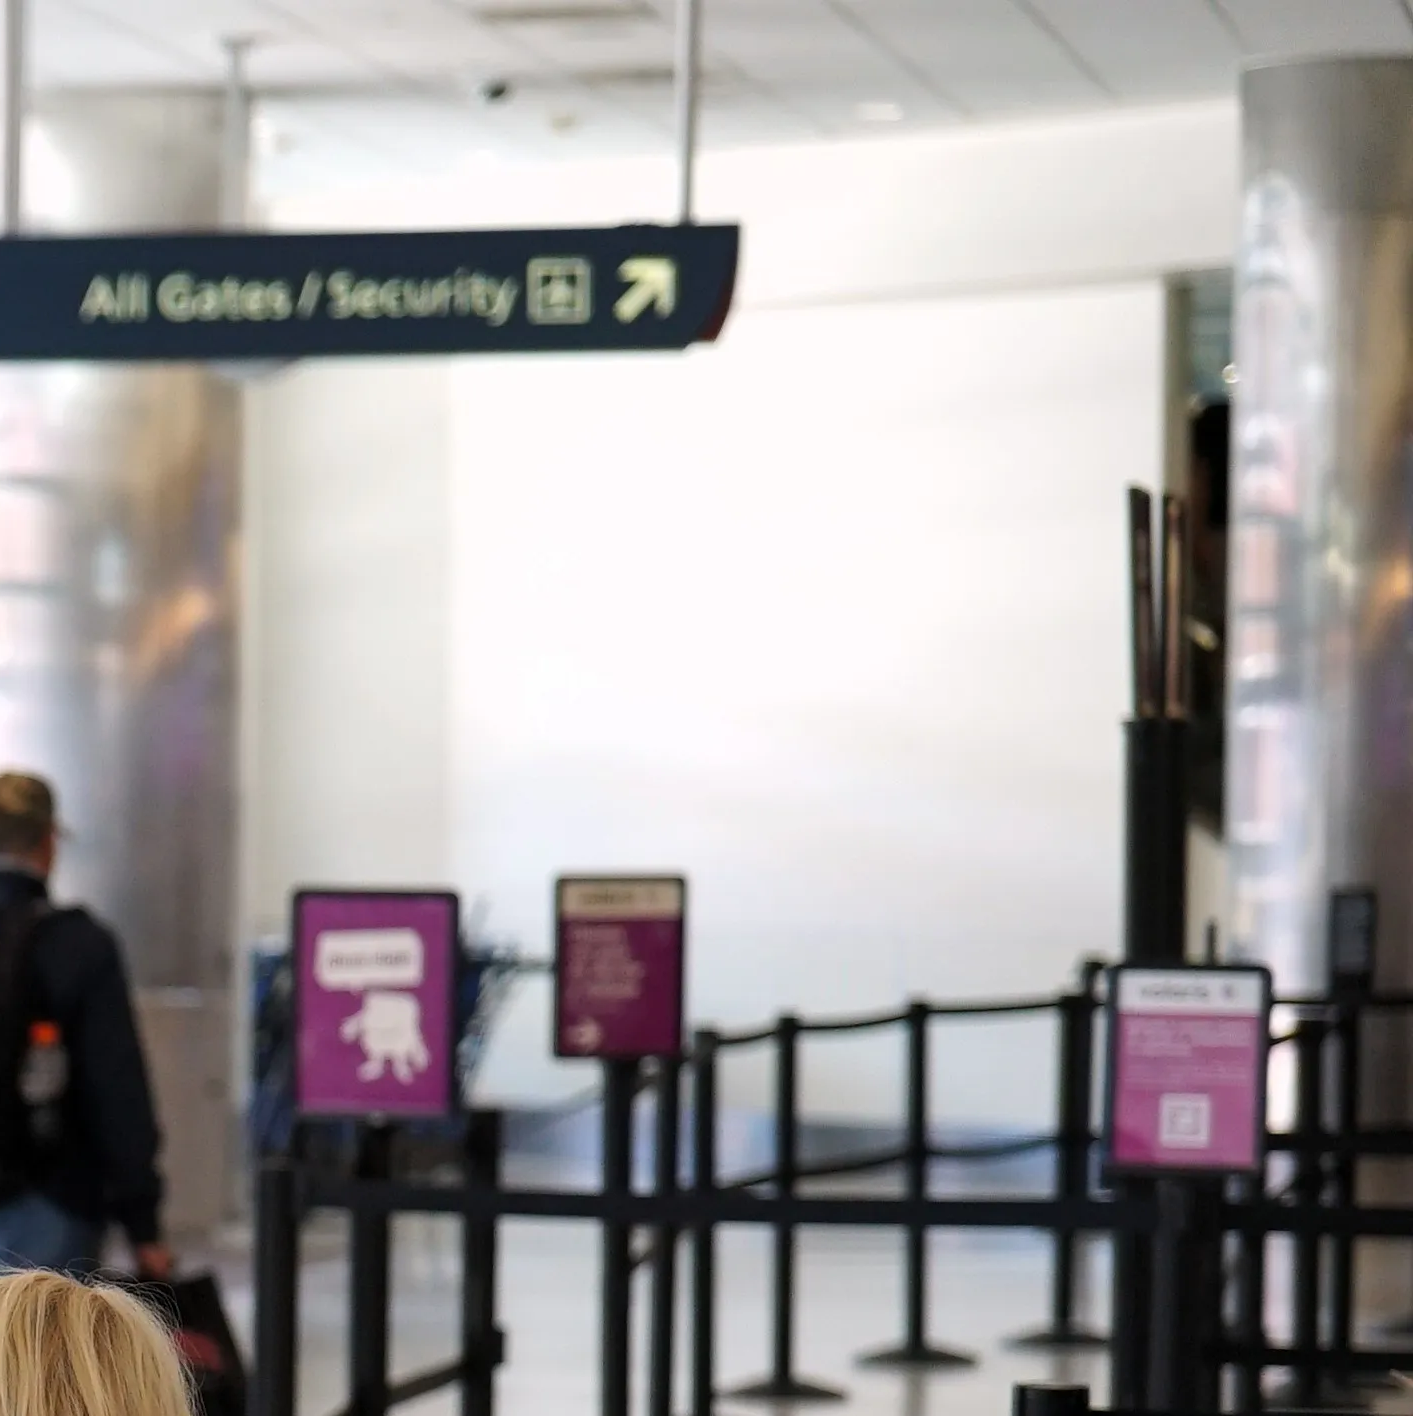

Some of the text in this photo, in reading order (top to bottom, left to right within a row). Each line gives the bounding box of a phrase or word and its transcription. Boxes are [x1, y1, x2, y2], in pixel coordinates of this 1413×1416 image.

[78, 266, 519, 327] All Gates / Security
